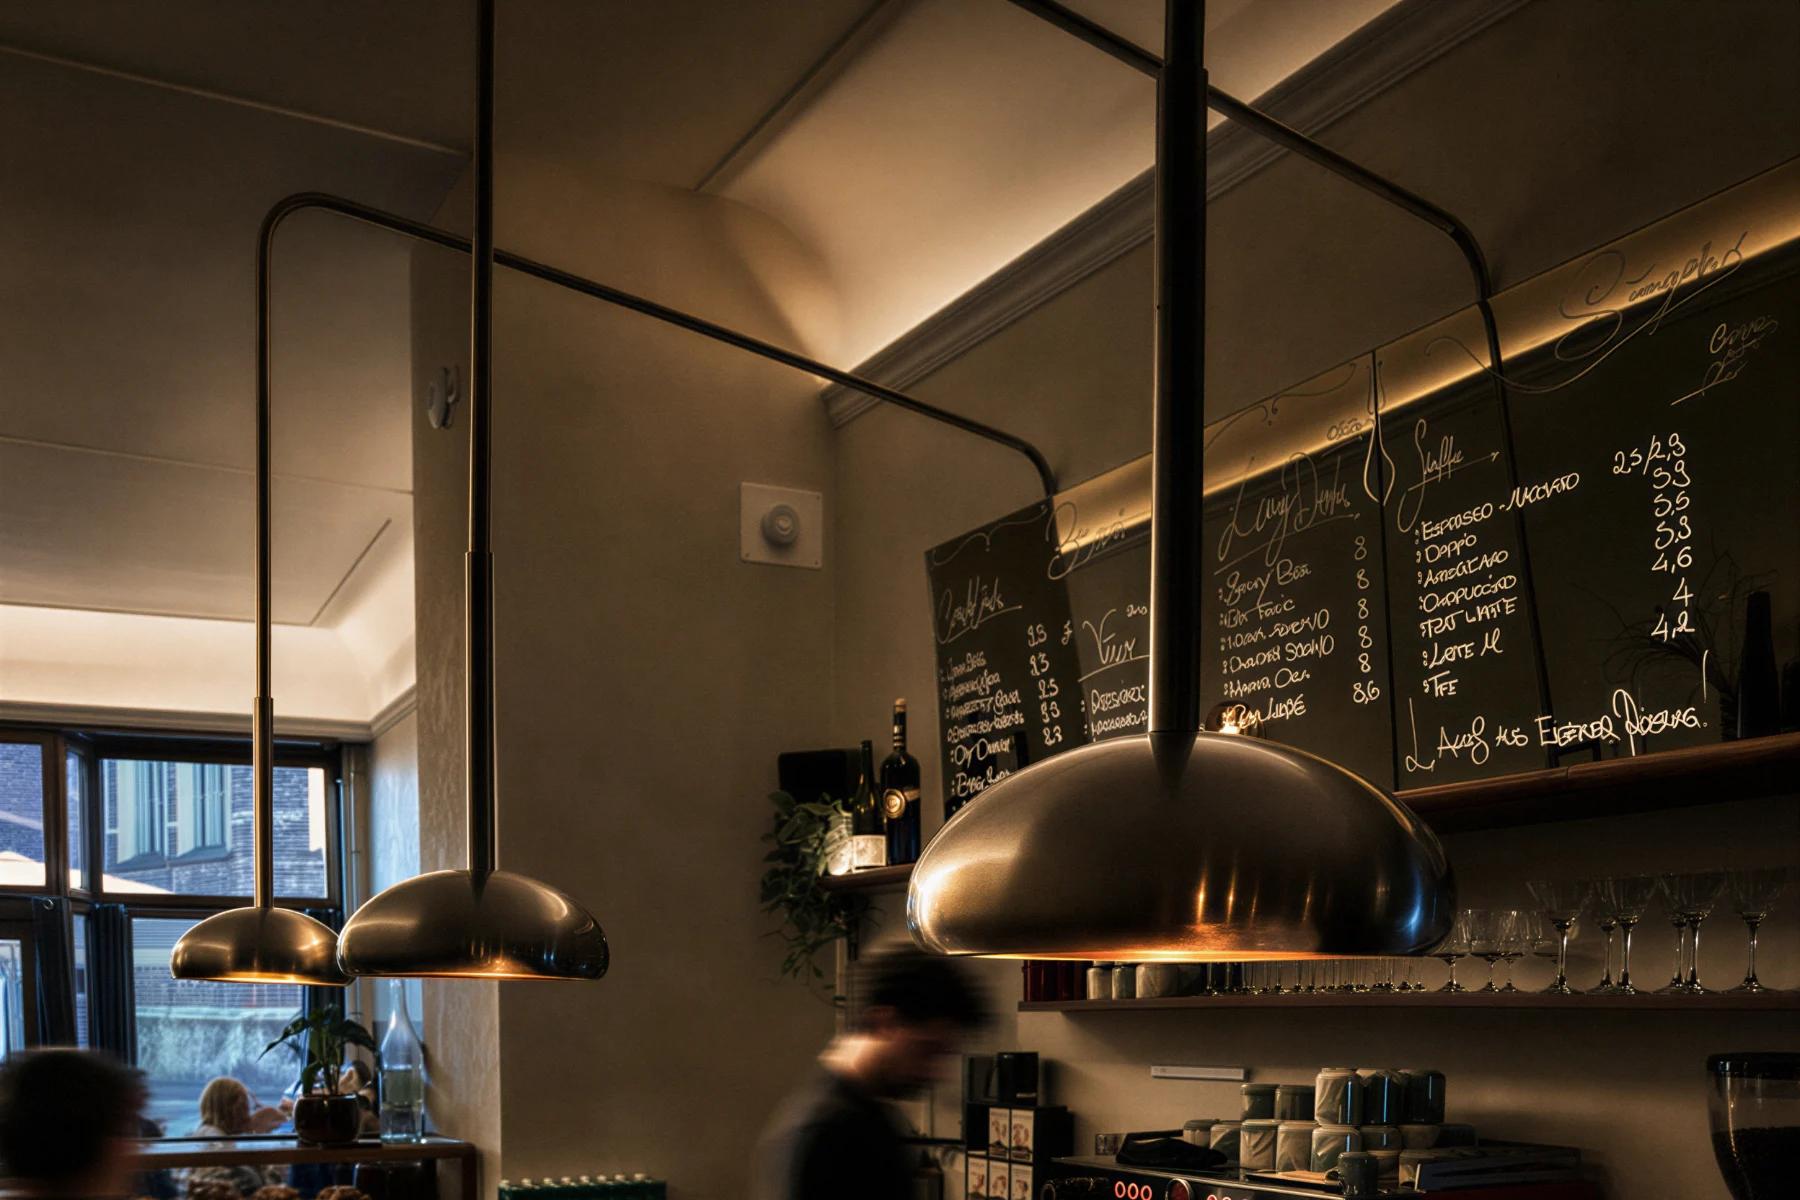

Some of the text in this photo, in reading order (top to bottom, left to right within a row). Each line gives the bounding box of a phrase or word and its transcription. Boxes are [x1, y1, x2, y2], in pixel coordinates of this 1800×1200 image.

[1651, 546, 1693, 573] 4,6
[1672, 577, 1693, 607] 4
[1651, 611, 1695, 642] 4,2
